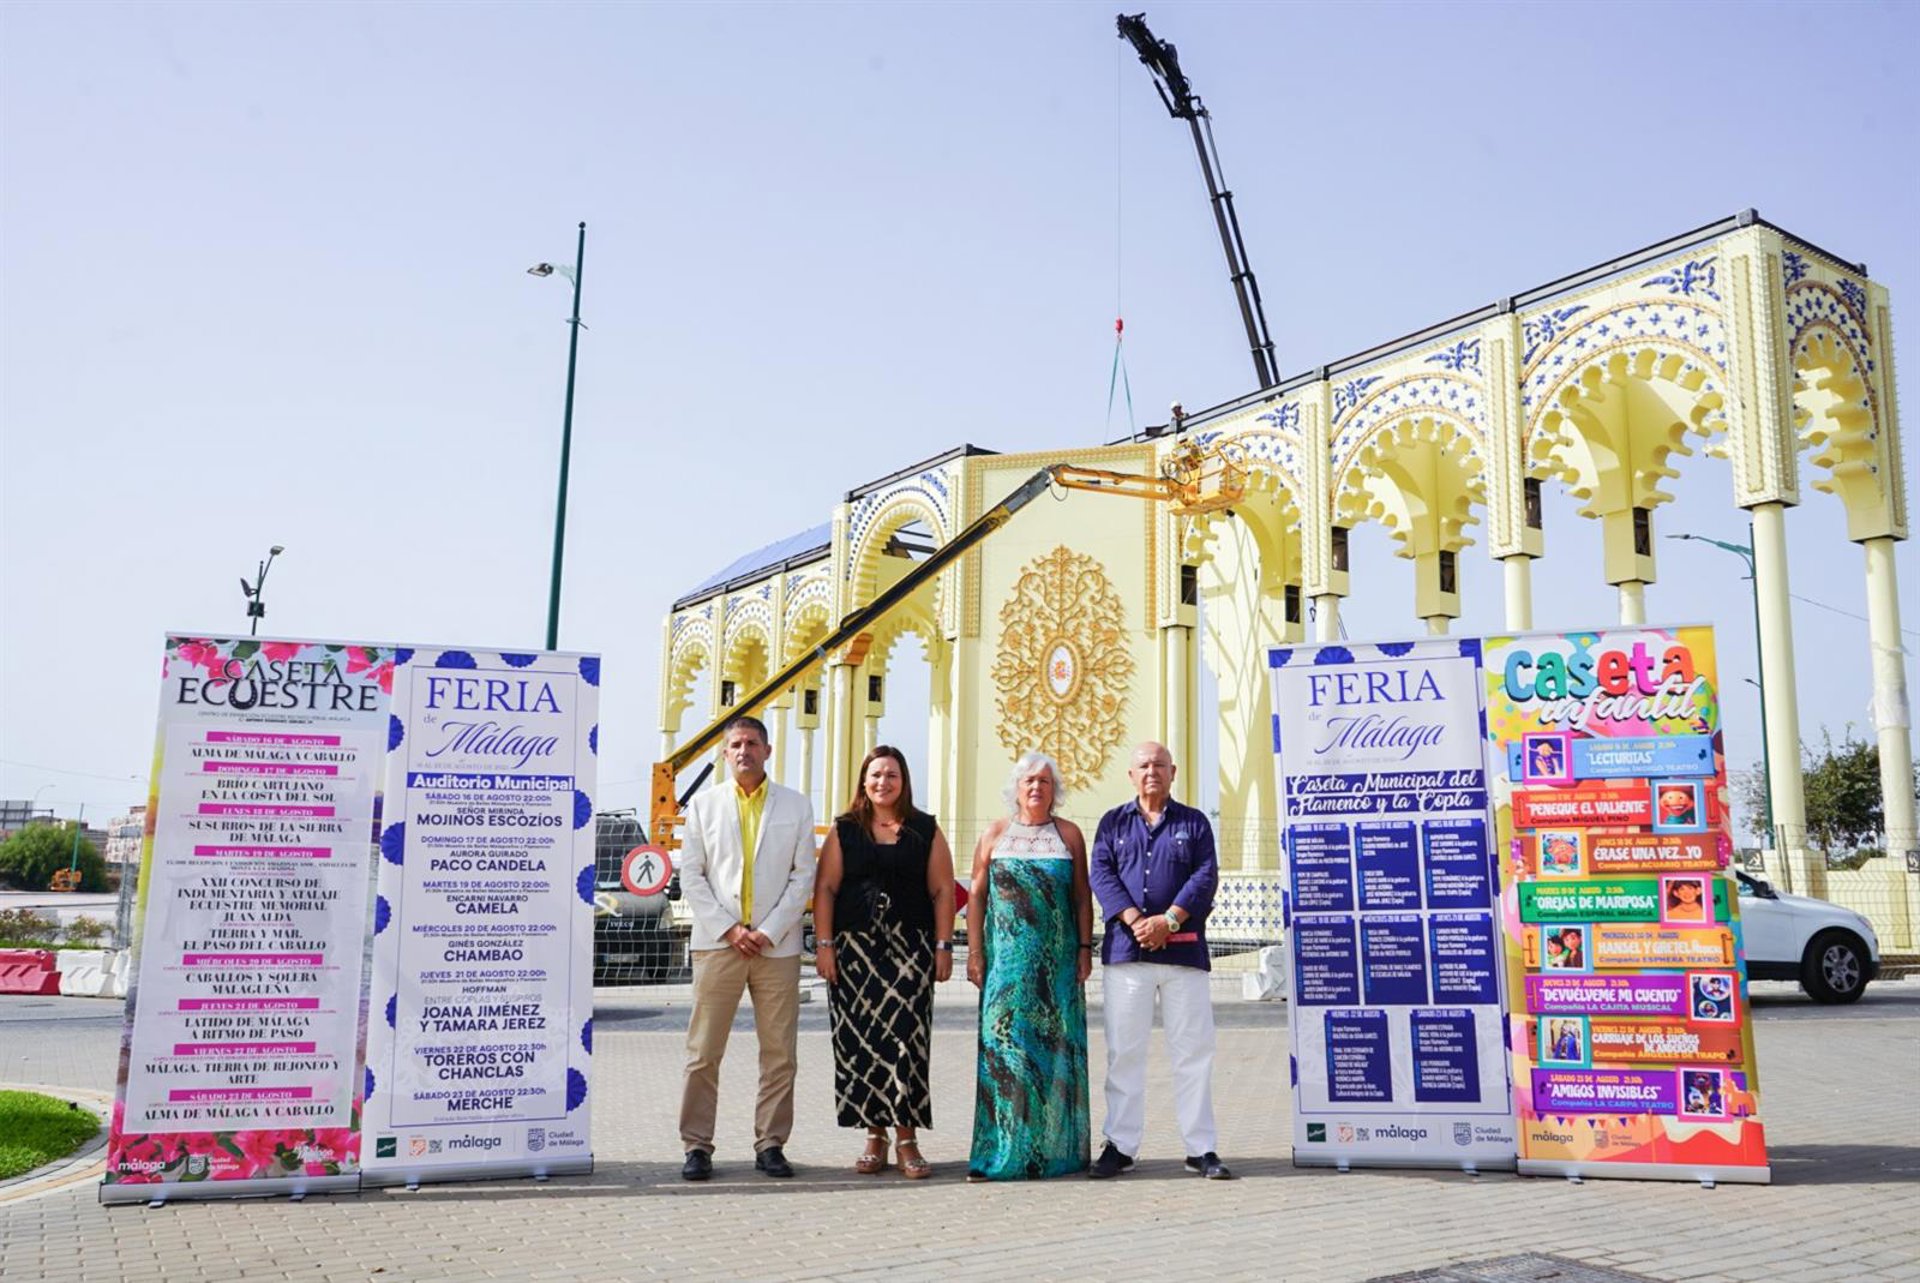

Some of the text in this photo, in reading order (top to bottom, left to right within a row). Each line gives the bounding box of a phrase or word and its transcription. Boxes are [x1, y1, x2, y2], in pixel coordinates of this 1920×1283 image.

[224, 658, 344, 684] CASETA
[177, 677, 379, 711] ECUESTRE
[1307, 670, 1445, 706] FERIA
[425, 677, 562, 713] FERIA
[1539, 675, 1705, 738] infantil
[423, 715, 437, 723] de
[1308, 712, 1321, 720] de
[1314, 714, 1445, 760] Málaga
[426, 722, 559, 769] Málaga
[191, 749, 221, 758] ALMA
[225, 750, 240, 759] DE
[295, 753, 301, 761] A
[304, 753, 356, 762] CABALLO
[413, 774, 573, 790] Auditorio Municipal
[1290, 770, 1477, 796] Caseta Municipal del
[202, 790, 336, 802] EN LA COSTA DEL SOL
[425, 792, 460, 800] SÁBADO
[457, 806, 486, 814] SEÑOR
[1290, 791, 1473, 818] Flamenco y la Copla
[1581, 802, 1593, 813] EL
[417, 813, 562, 826] MOJINOS ESCOZÍOS
[189, 821, 343, 833] SUSURROS DE LA SIERRA
[230, 833, 247, 842] DE
[1594, 845, 1629, 860] ÉRASE
[1632, 847, 1653, 860] UNA
[431, 860, 546, 871] PACO CANDELA
[231, 878, 300, 888] CONCURSO
[305, 878, 321, 888] DE
[190, 901, 327, 911] ECUESTRE MEMORIAL
[456, 903, 518, 914] CAMELA
[1579, 897, 1593, 909] DE
[224, 912, 291, 922] JUAN ALDA
[413, 924, 462, 932] MIÉRCOLES
[183, 941, 326, 950] EL PASO DEL CABALLO
[449, 938, 523, 947] GINÉS GONZÁLEZ
[444, 950, 523, 961] CHAMBAO
[186, 972, 317, 982] CABALLOS Y SOLERA
[213, 983, 290, 994] MALAGUEÑA
[1618, 989, 1632, 1002] MI
[422, 1002, 540, 1018] JOANA JIMÉNEZ
[185, 1015, 310, 1027] LATIDO DE MÁLAGA
[420, 1018, 546, 1032] Y TAMARA JEREZ
[192, 1029, 303, 1039] A RITMO DE PASO
[424, 1052, 535, 1066] TOREROS CON
[439, 1066, 523, 1080] CHANCLAS
[227, 1075, 258, 1084] ARTE
[414, 1091, 450, 1100] SÁBADO
[447, 1097, 513, 1111] MERCHE
[142, 1106, 334, 1121] ALMA DE MÁLAGA A CABALLO
[1375, 1124, 1427, 1140] málaga
[1532, 1131, 1574, 1144] málaga
[449, 1135, 501, 1150] málaga
[118, 1158, 166, 1171] málaga
